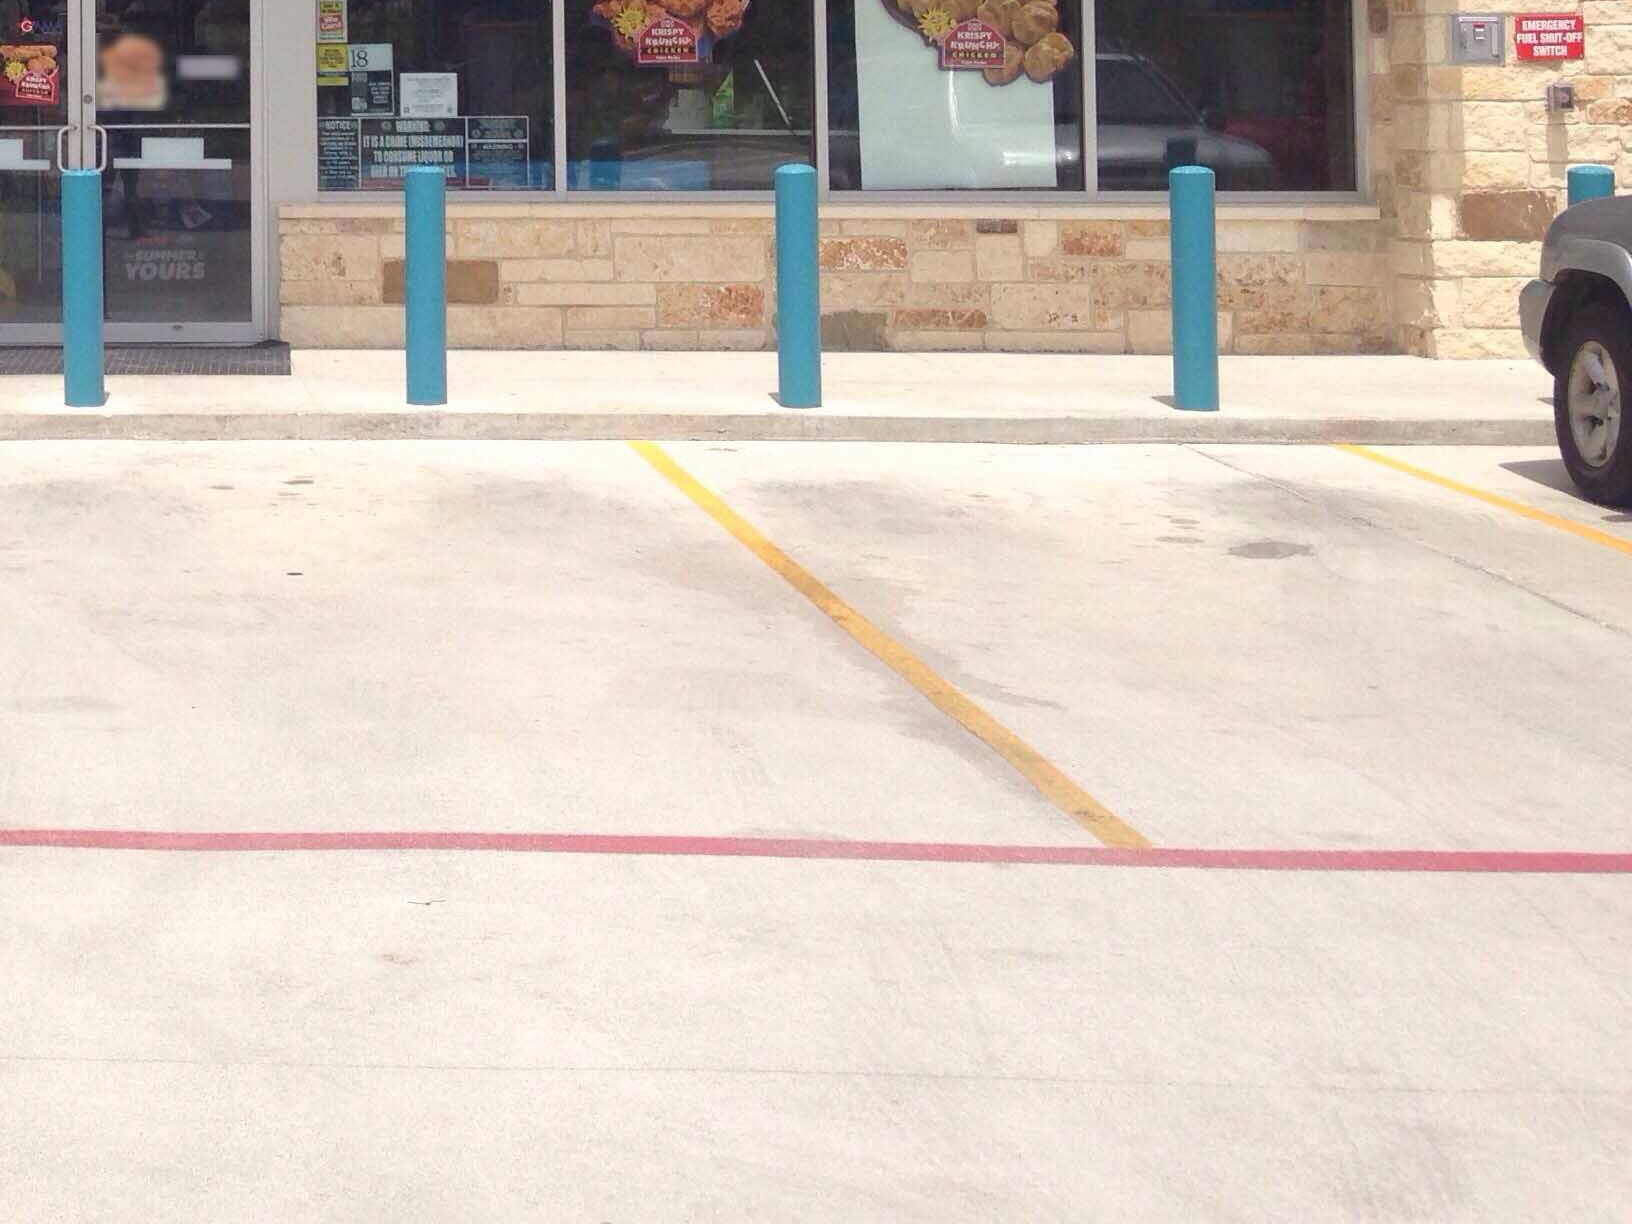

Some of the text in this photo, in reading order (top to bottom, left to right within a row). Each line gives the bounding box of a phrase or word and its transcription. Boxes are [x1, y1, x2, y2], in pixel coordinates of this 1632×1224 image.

[1521, 19, 1577, 31] EMERGENCY
[651, 28, 685, 36] KRISPY
[957, 32, 993, 40] KRISPY
[1516, 32, 1583, 44] FUEL SHUT-OFF
[1532, 45, 1568, 56] SWITCH
[351, 49, 368, 68] 18
[126, 263, 206, 281] YOURS
